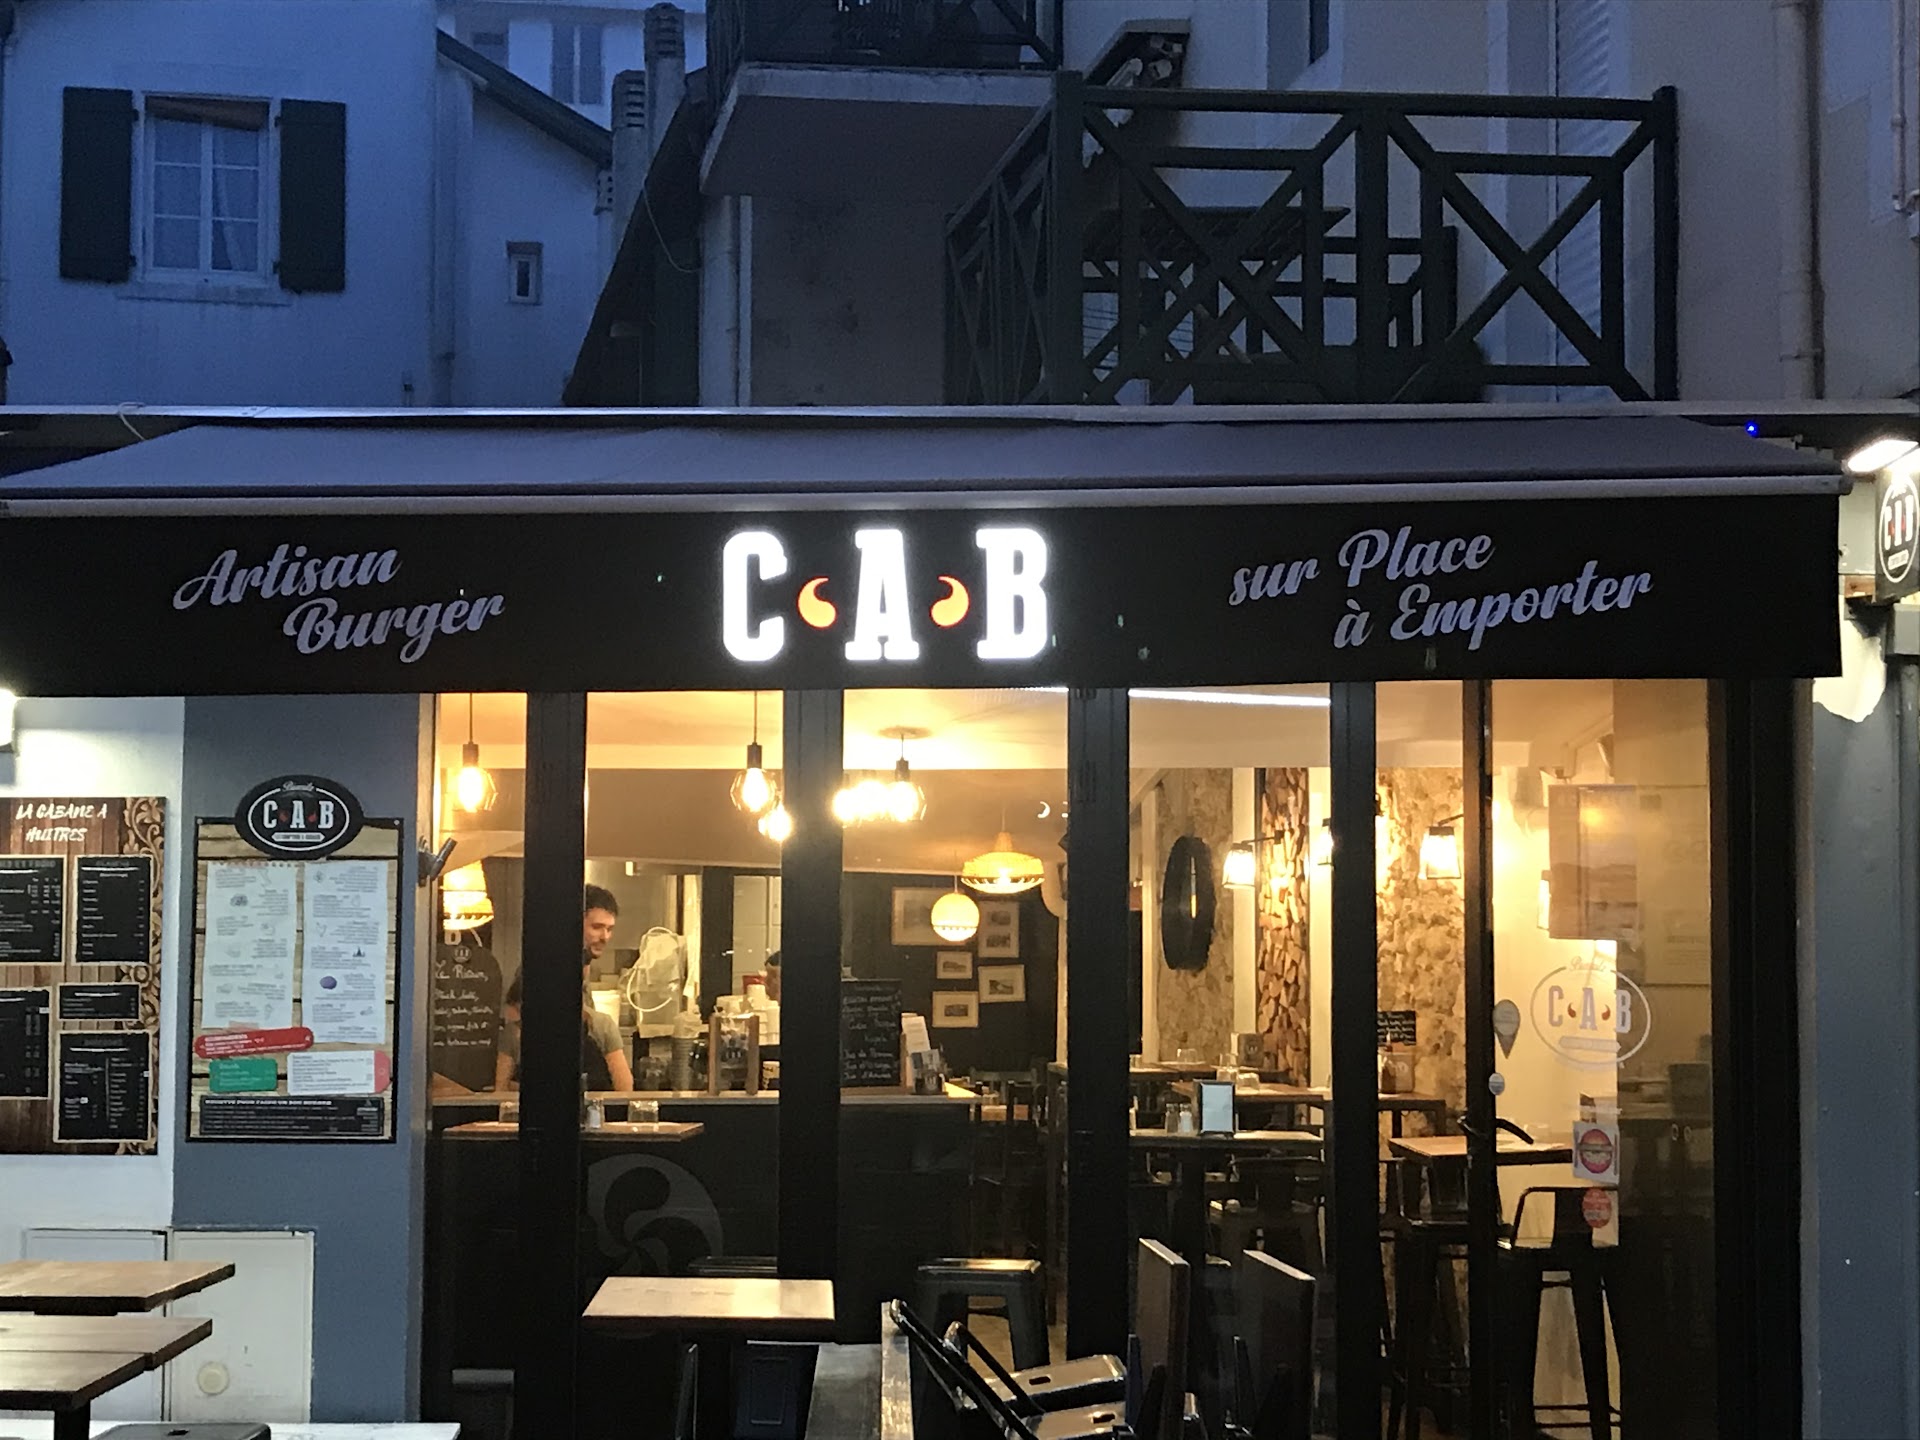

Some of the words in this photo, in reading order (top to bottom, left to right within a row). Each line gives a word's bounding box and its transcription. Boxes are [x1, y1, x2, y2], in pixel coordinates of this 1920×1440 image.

[173, 544, 401, 610] Artisan
[1228, 557, 1321, 606] sur
[1338, 526, 1496, 588] Place
[283, 597, 505, 664] Burger
[1333, 598, 1374, 649] à
[1389, 560, 1655, 651] Emporter
[25, 826, 88, 843] HUITRES
